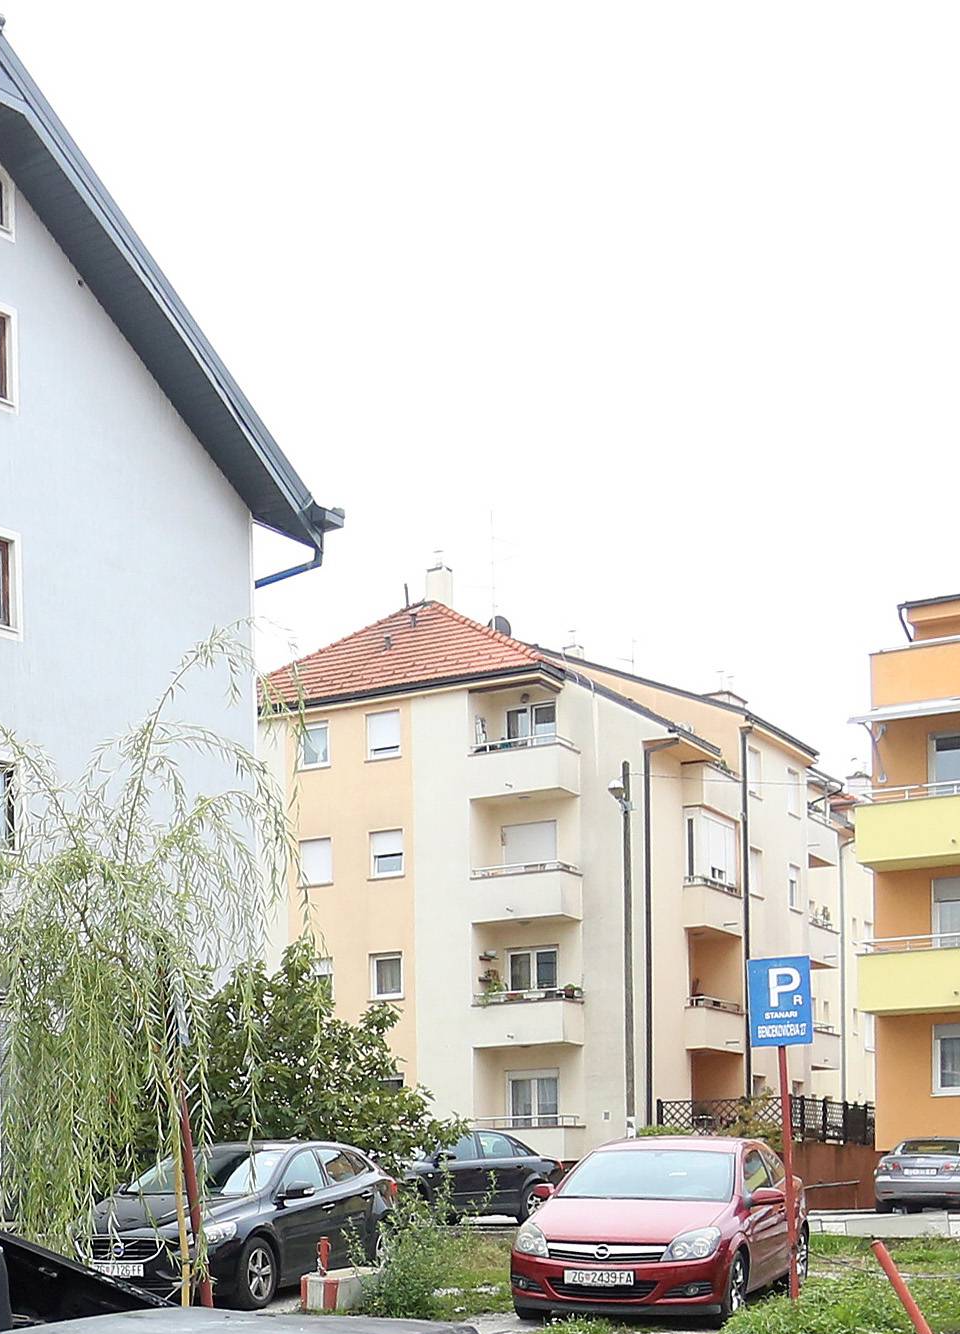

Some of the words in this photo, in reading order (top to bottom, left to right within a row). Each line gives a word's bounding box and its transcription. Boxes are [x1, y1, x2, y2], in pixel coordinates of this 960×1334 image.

[768, 967, 802, 1008] P
[793, 994, 803, 1006] R
[764, 1010, 798, 1020] STANARI
[572, 1271, 584, 1283] ZG
